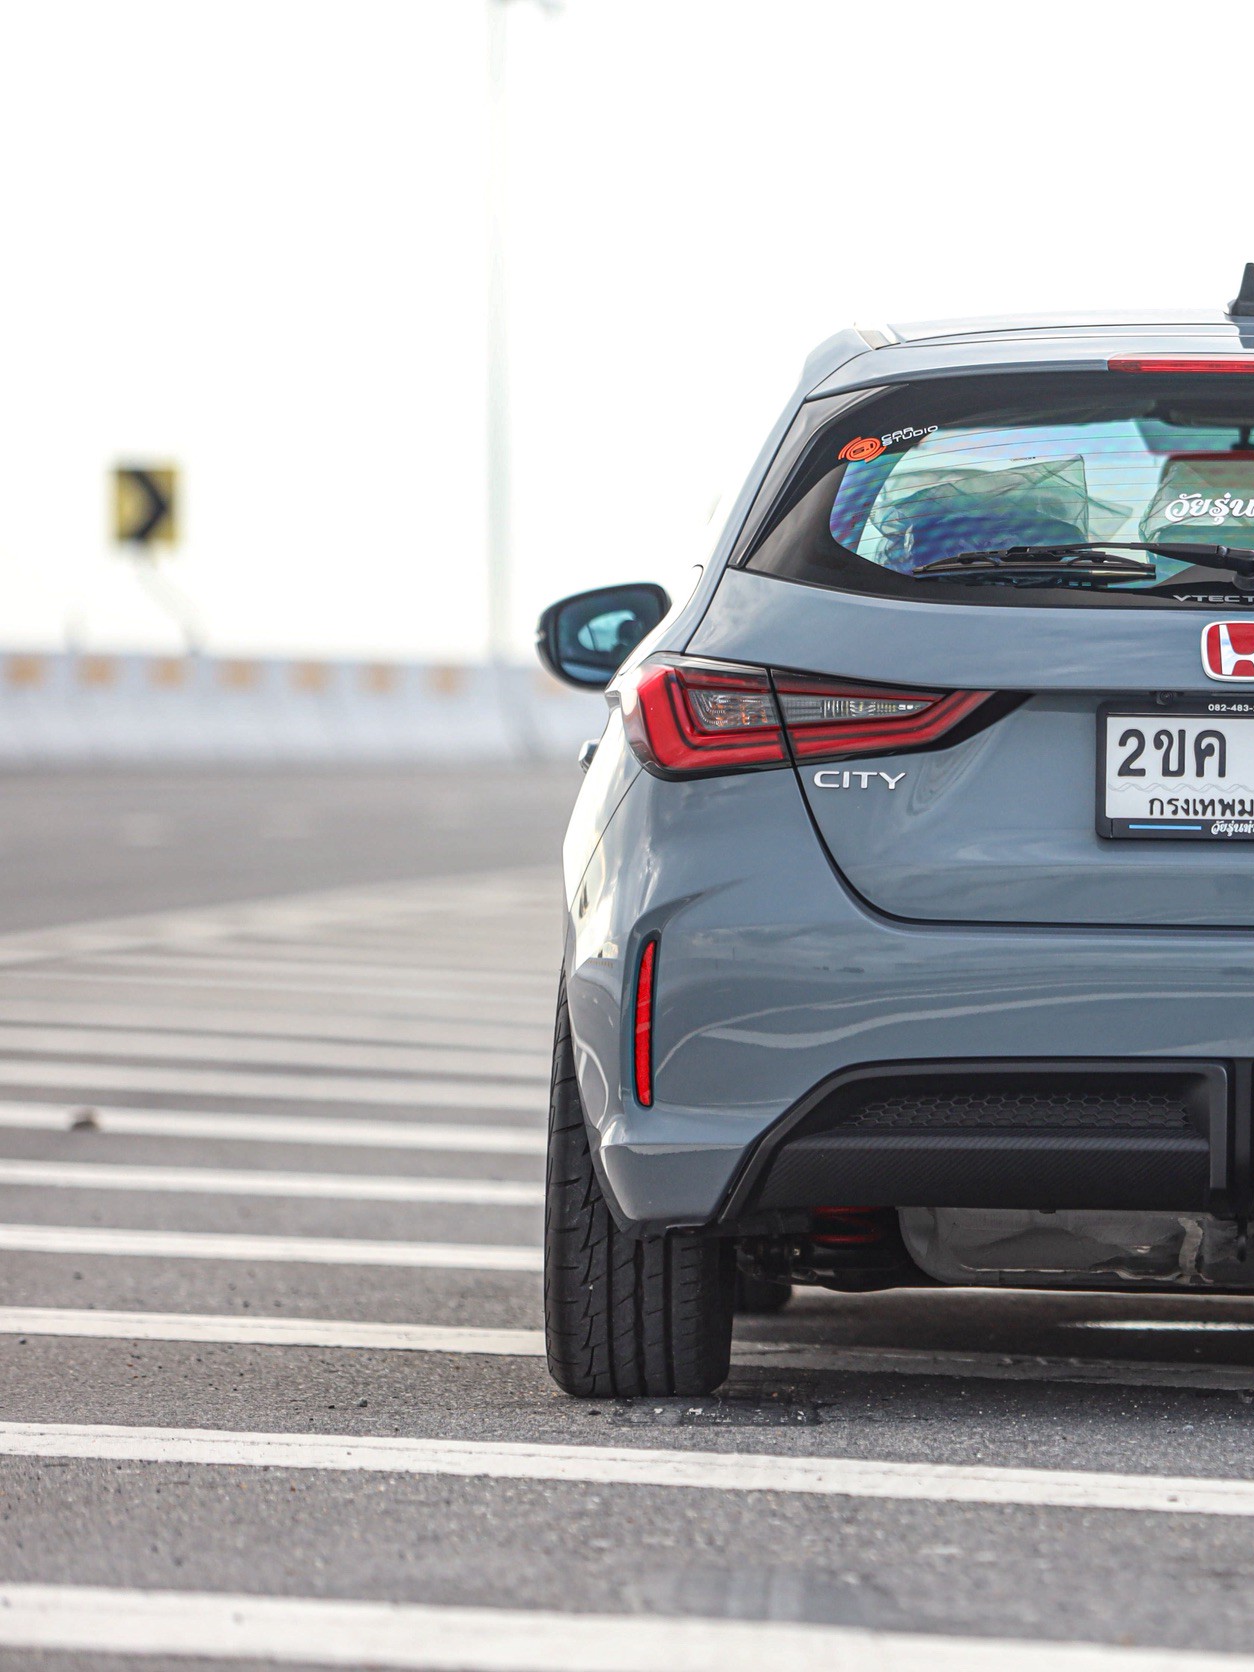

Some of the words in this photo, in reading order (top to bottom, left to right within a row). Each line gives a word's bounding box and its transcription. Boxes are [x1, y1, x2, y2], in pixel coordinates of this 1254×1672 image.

[882, 425, 939, 447] STUDIO
[1173, 594, 1240, 603] VTEC
[1117, 728, 1227, 778] 2ขค
[813, 771, 906, 790] CITY
